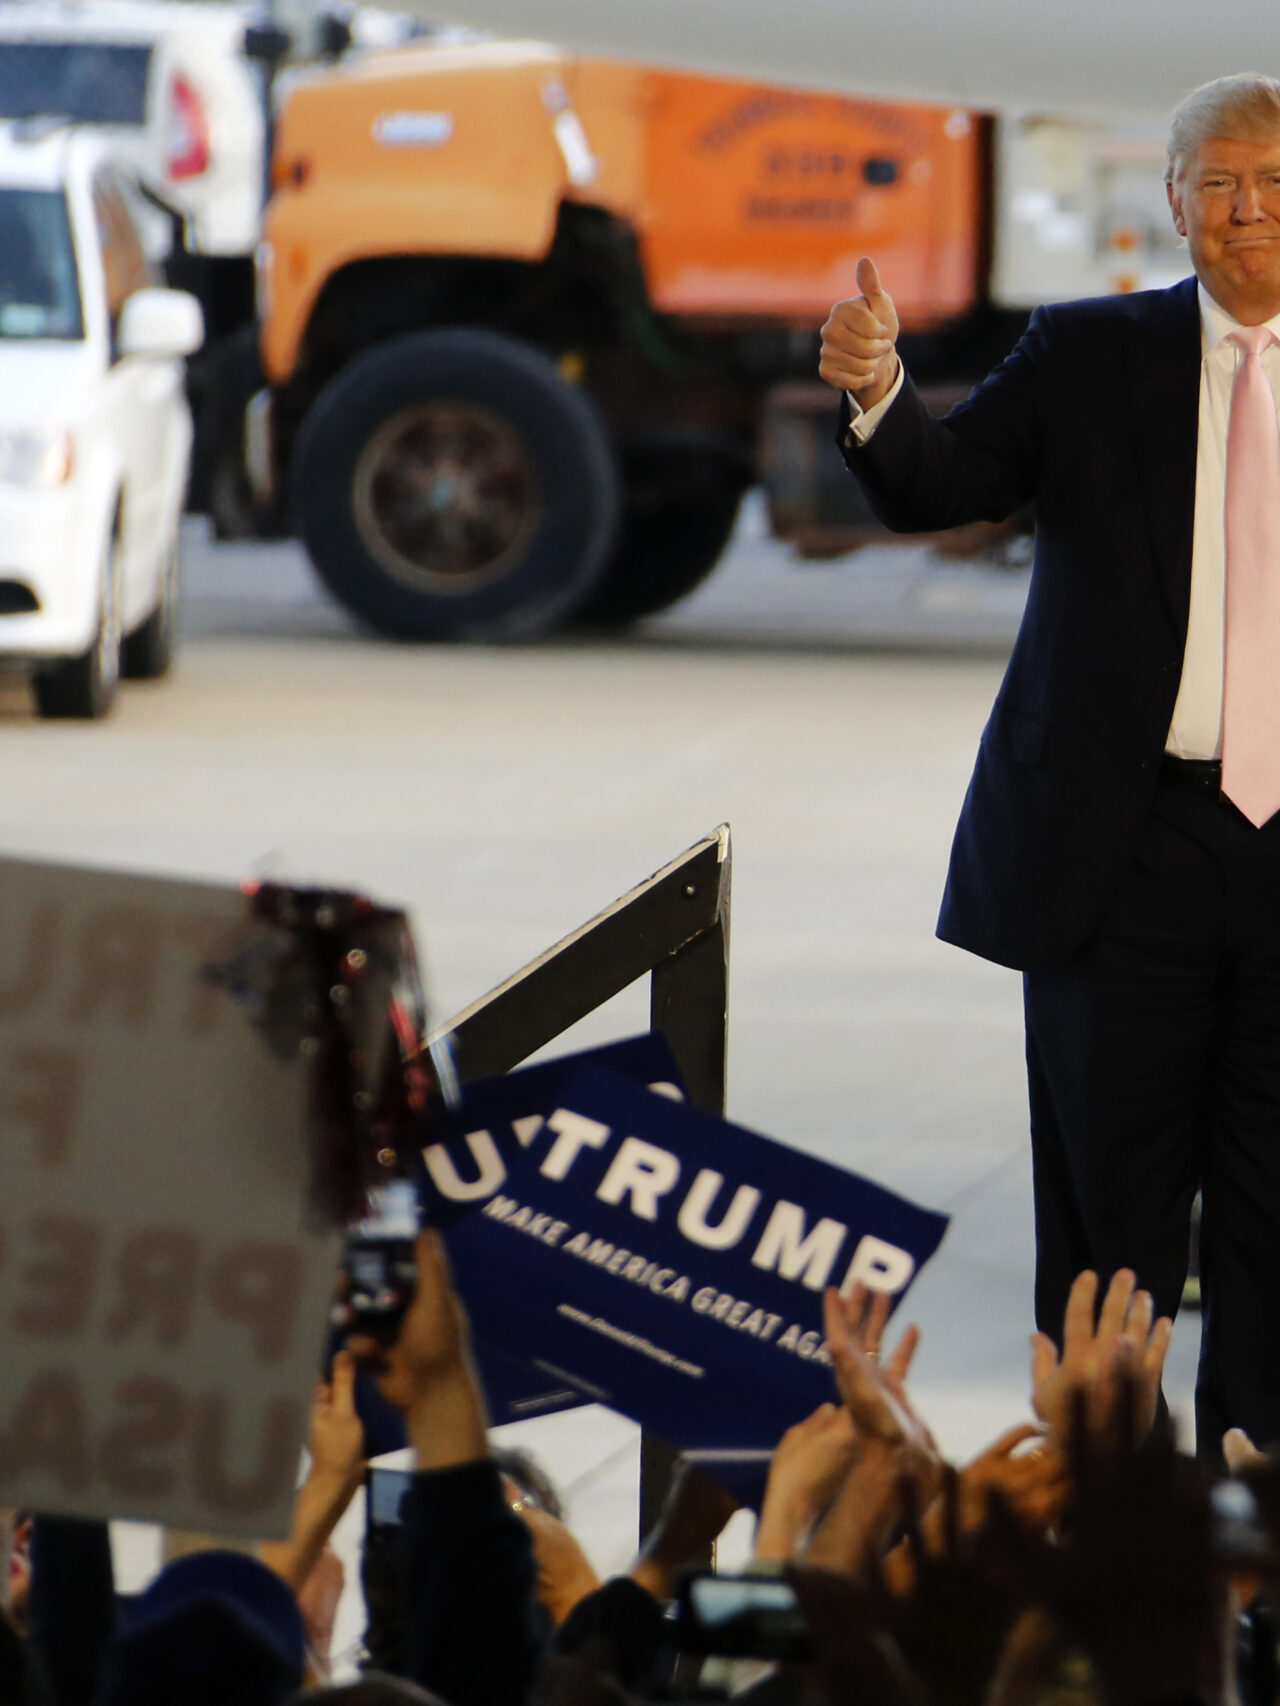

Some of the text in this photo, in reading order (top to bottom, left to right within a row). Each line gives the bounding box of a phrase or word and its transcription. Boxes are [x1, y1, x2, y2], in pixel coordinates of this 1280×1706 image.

[482, 1195, 570, 1247] MAKE
[562, 1231, 691, 1304] AMERICA
[690, 1287, 783, 1343] GREAT
[537, 1107, 916, 1300] TRUMP
